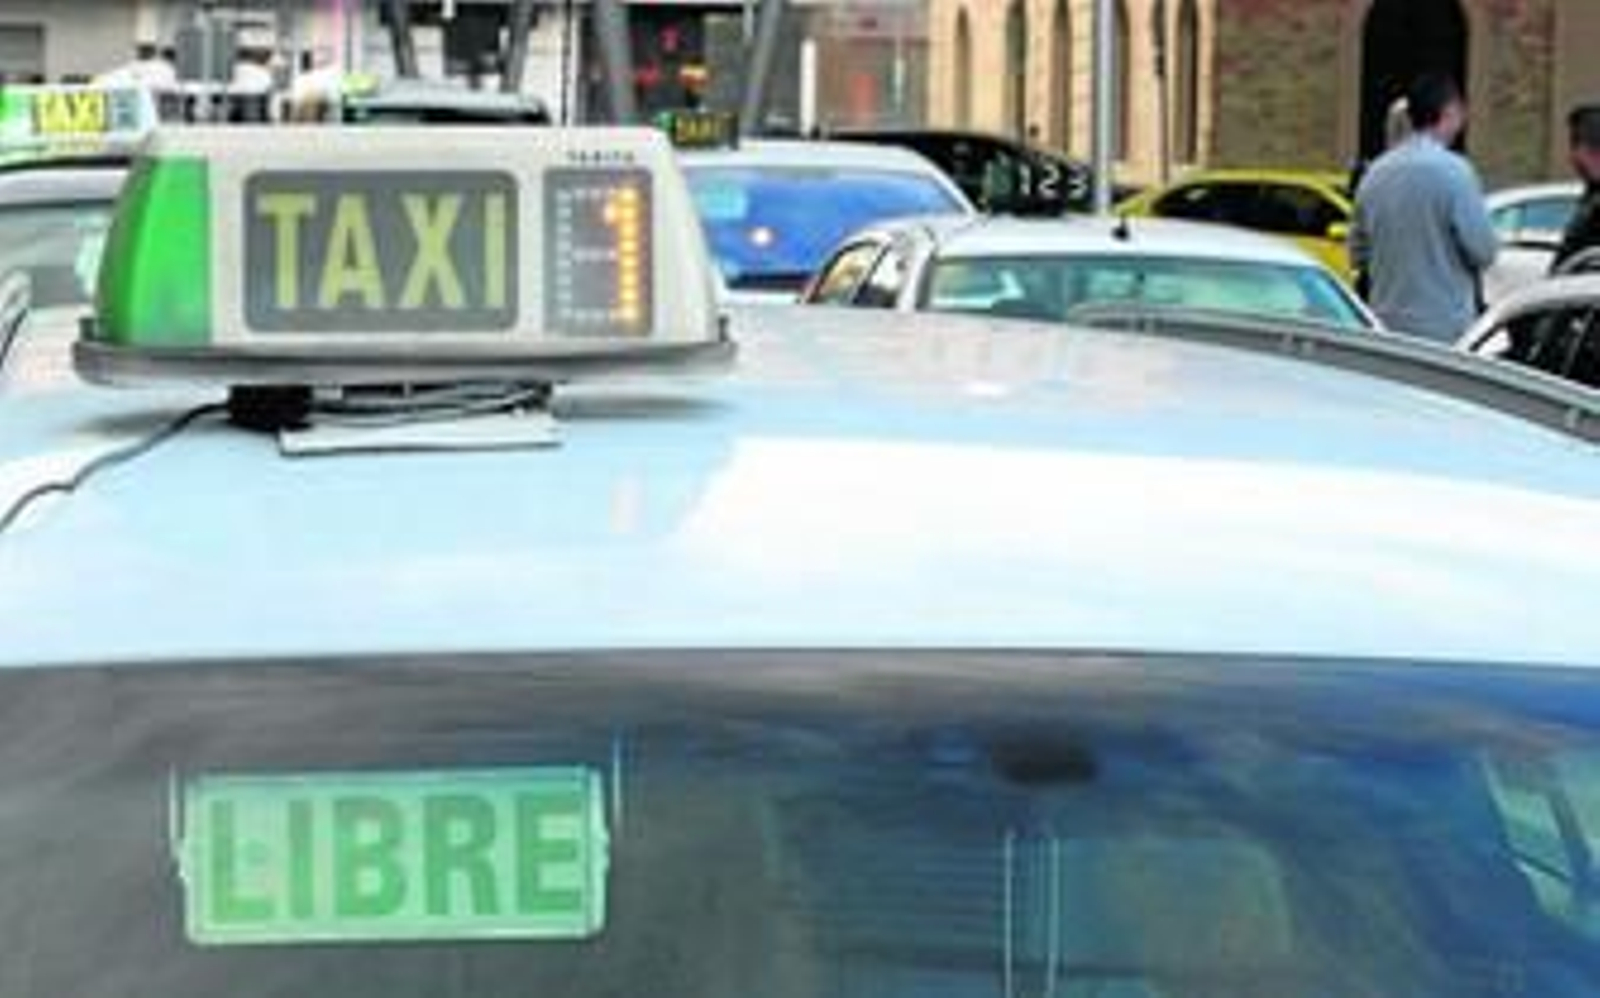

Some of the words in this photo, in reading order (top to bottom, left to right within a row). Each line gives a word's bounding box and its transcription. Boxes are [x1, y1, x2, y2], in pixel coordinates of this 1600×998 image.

[34, 91, 105, 132] TAXI
[258, 192, 506, 309] TAXI
[603, 187, 641, 319] 1
[209, 794, 582, 922] LIBRE
